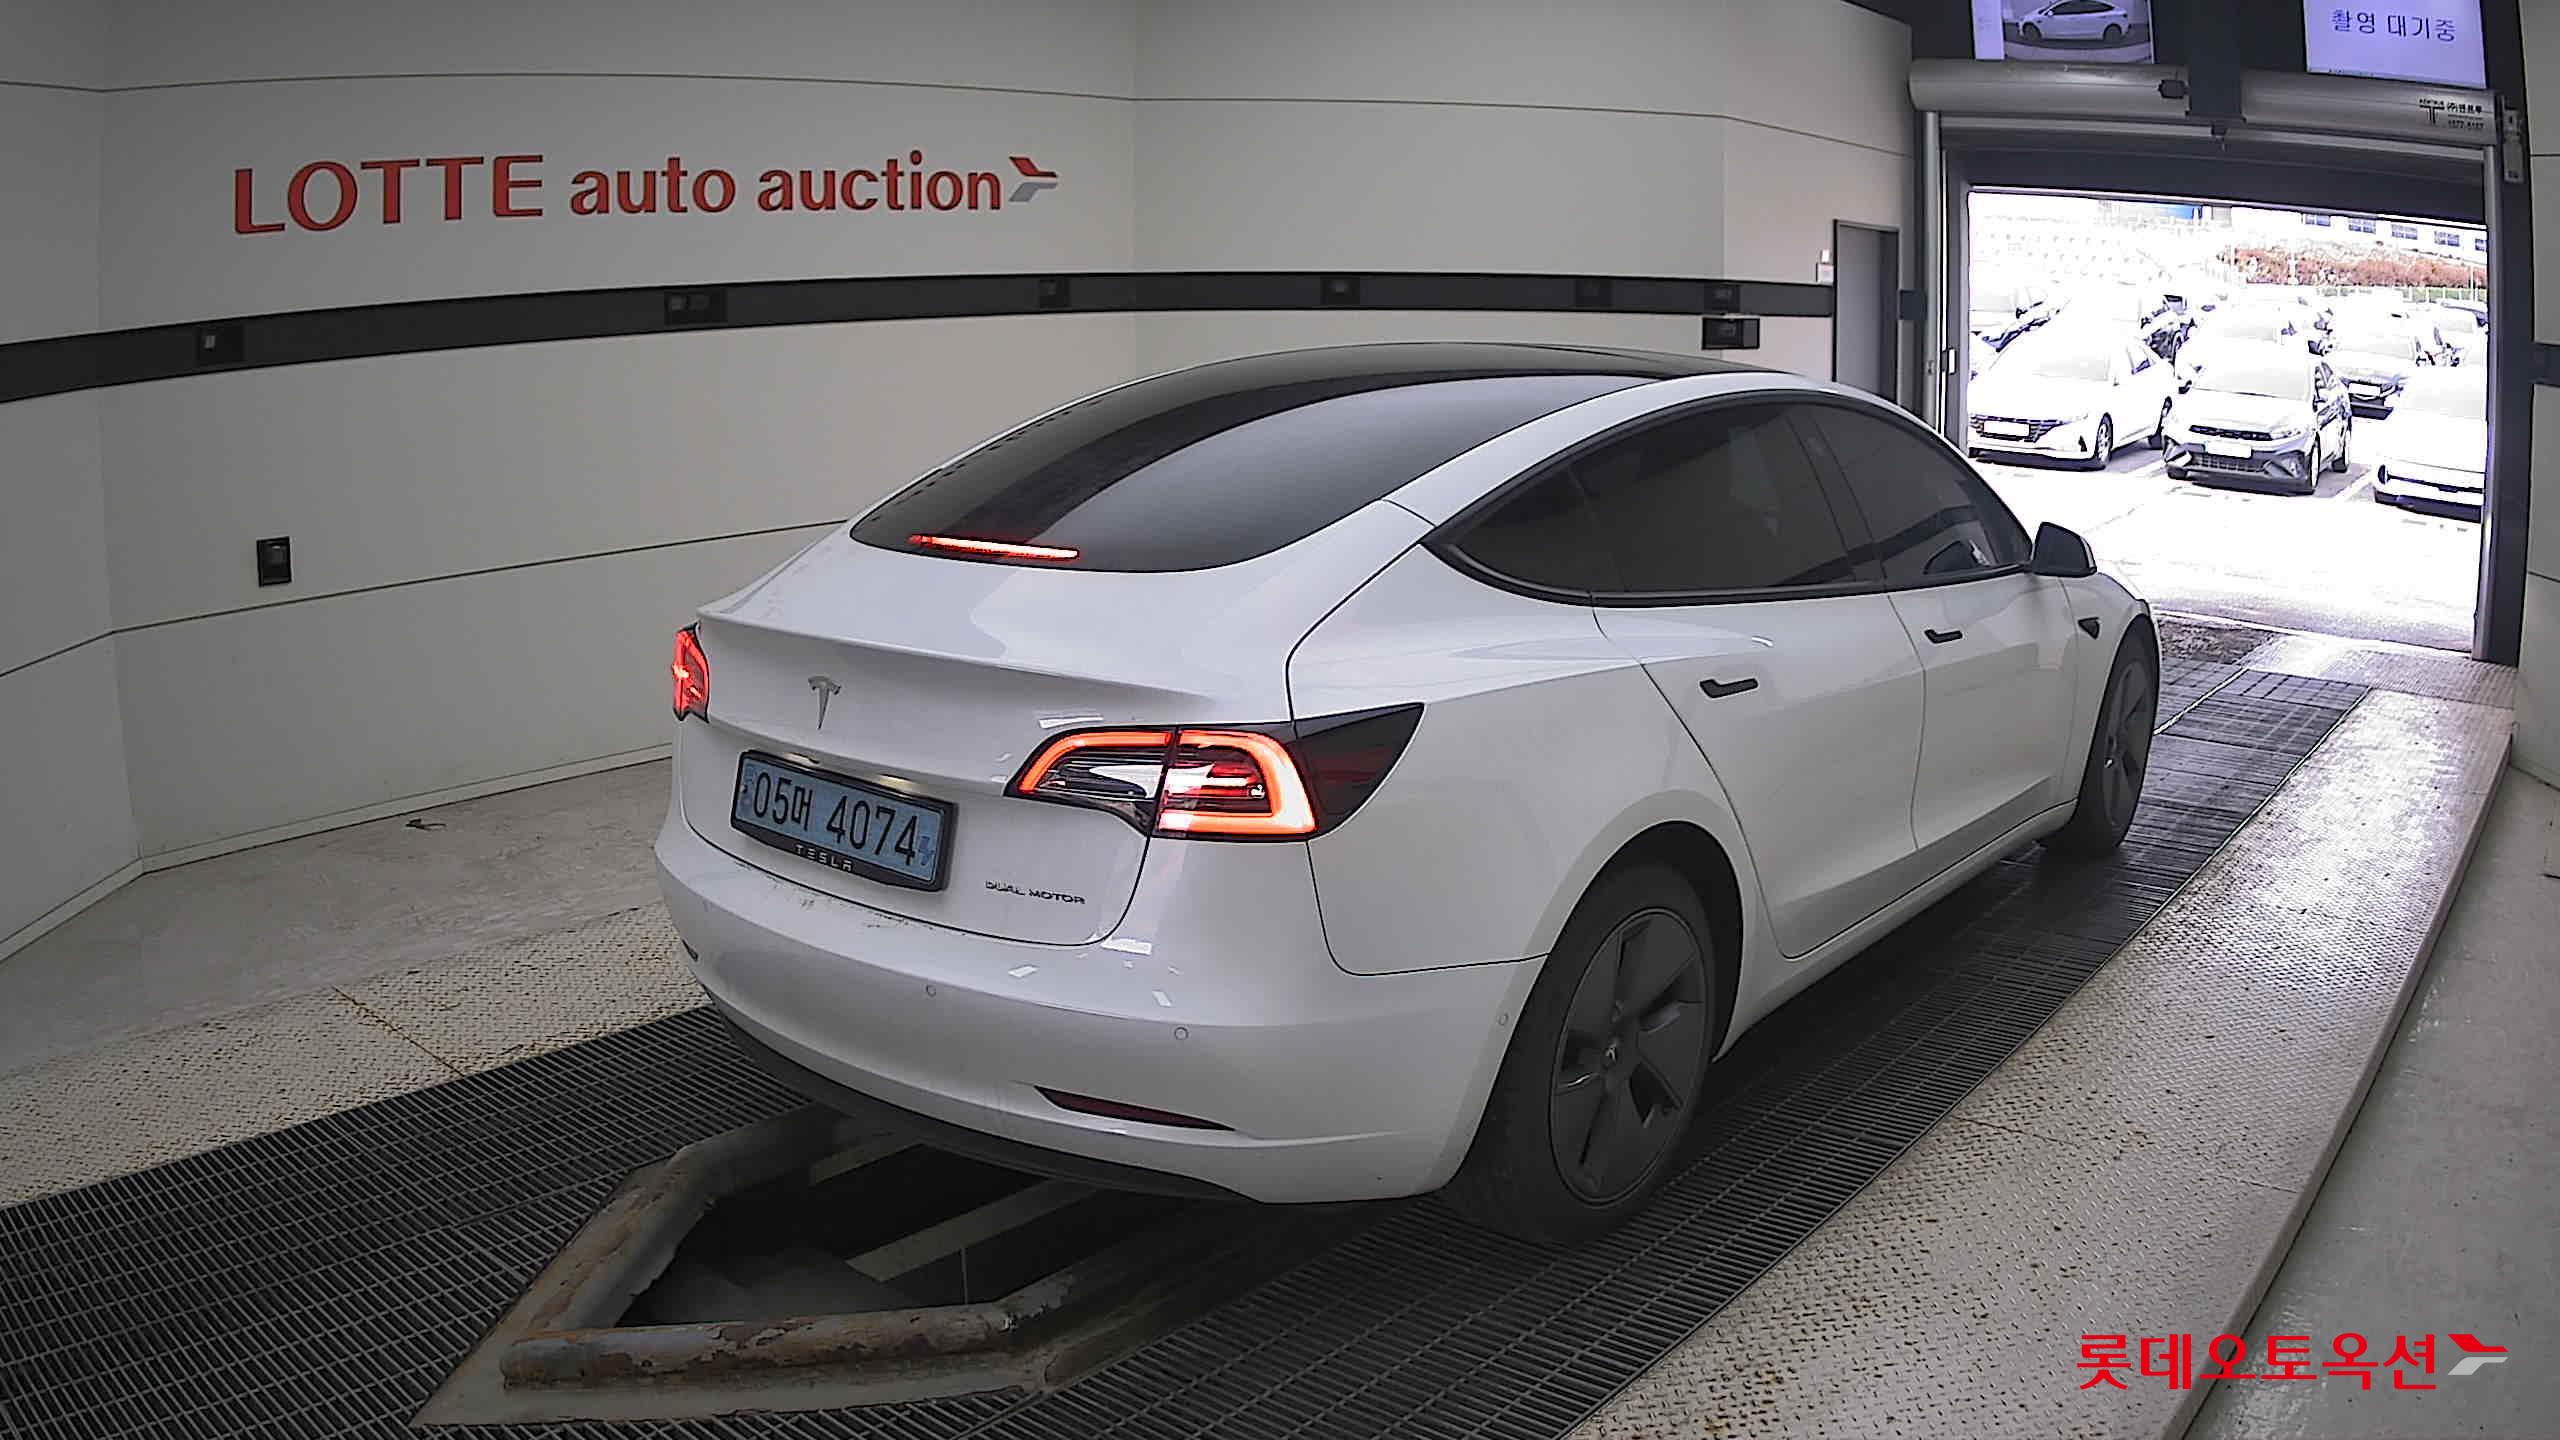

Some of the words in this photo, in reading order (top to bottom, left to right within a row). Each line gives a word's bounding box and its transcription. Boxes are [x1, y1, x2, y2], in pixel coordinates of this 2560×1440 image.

[2387, 15, 2457, 43] 대기중
[234, 154, 544, 234] LOTTE
[569, 156, 737, 215] auto
[757, 149, 1003, 212] auction
[825, 794, 919, 867] 4074
[795, 844, 853, 872] TESLA
[985, 879, 1026, 896] DUAL
[1028, 888, 1086, 905] MOTOR
